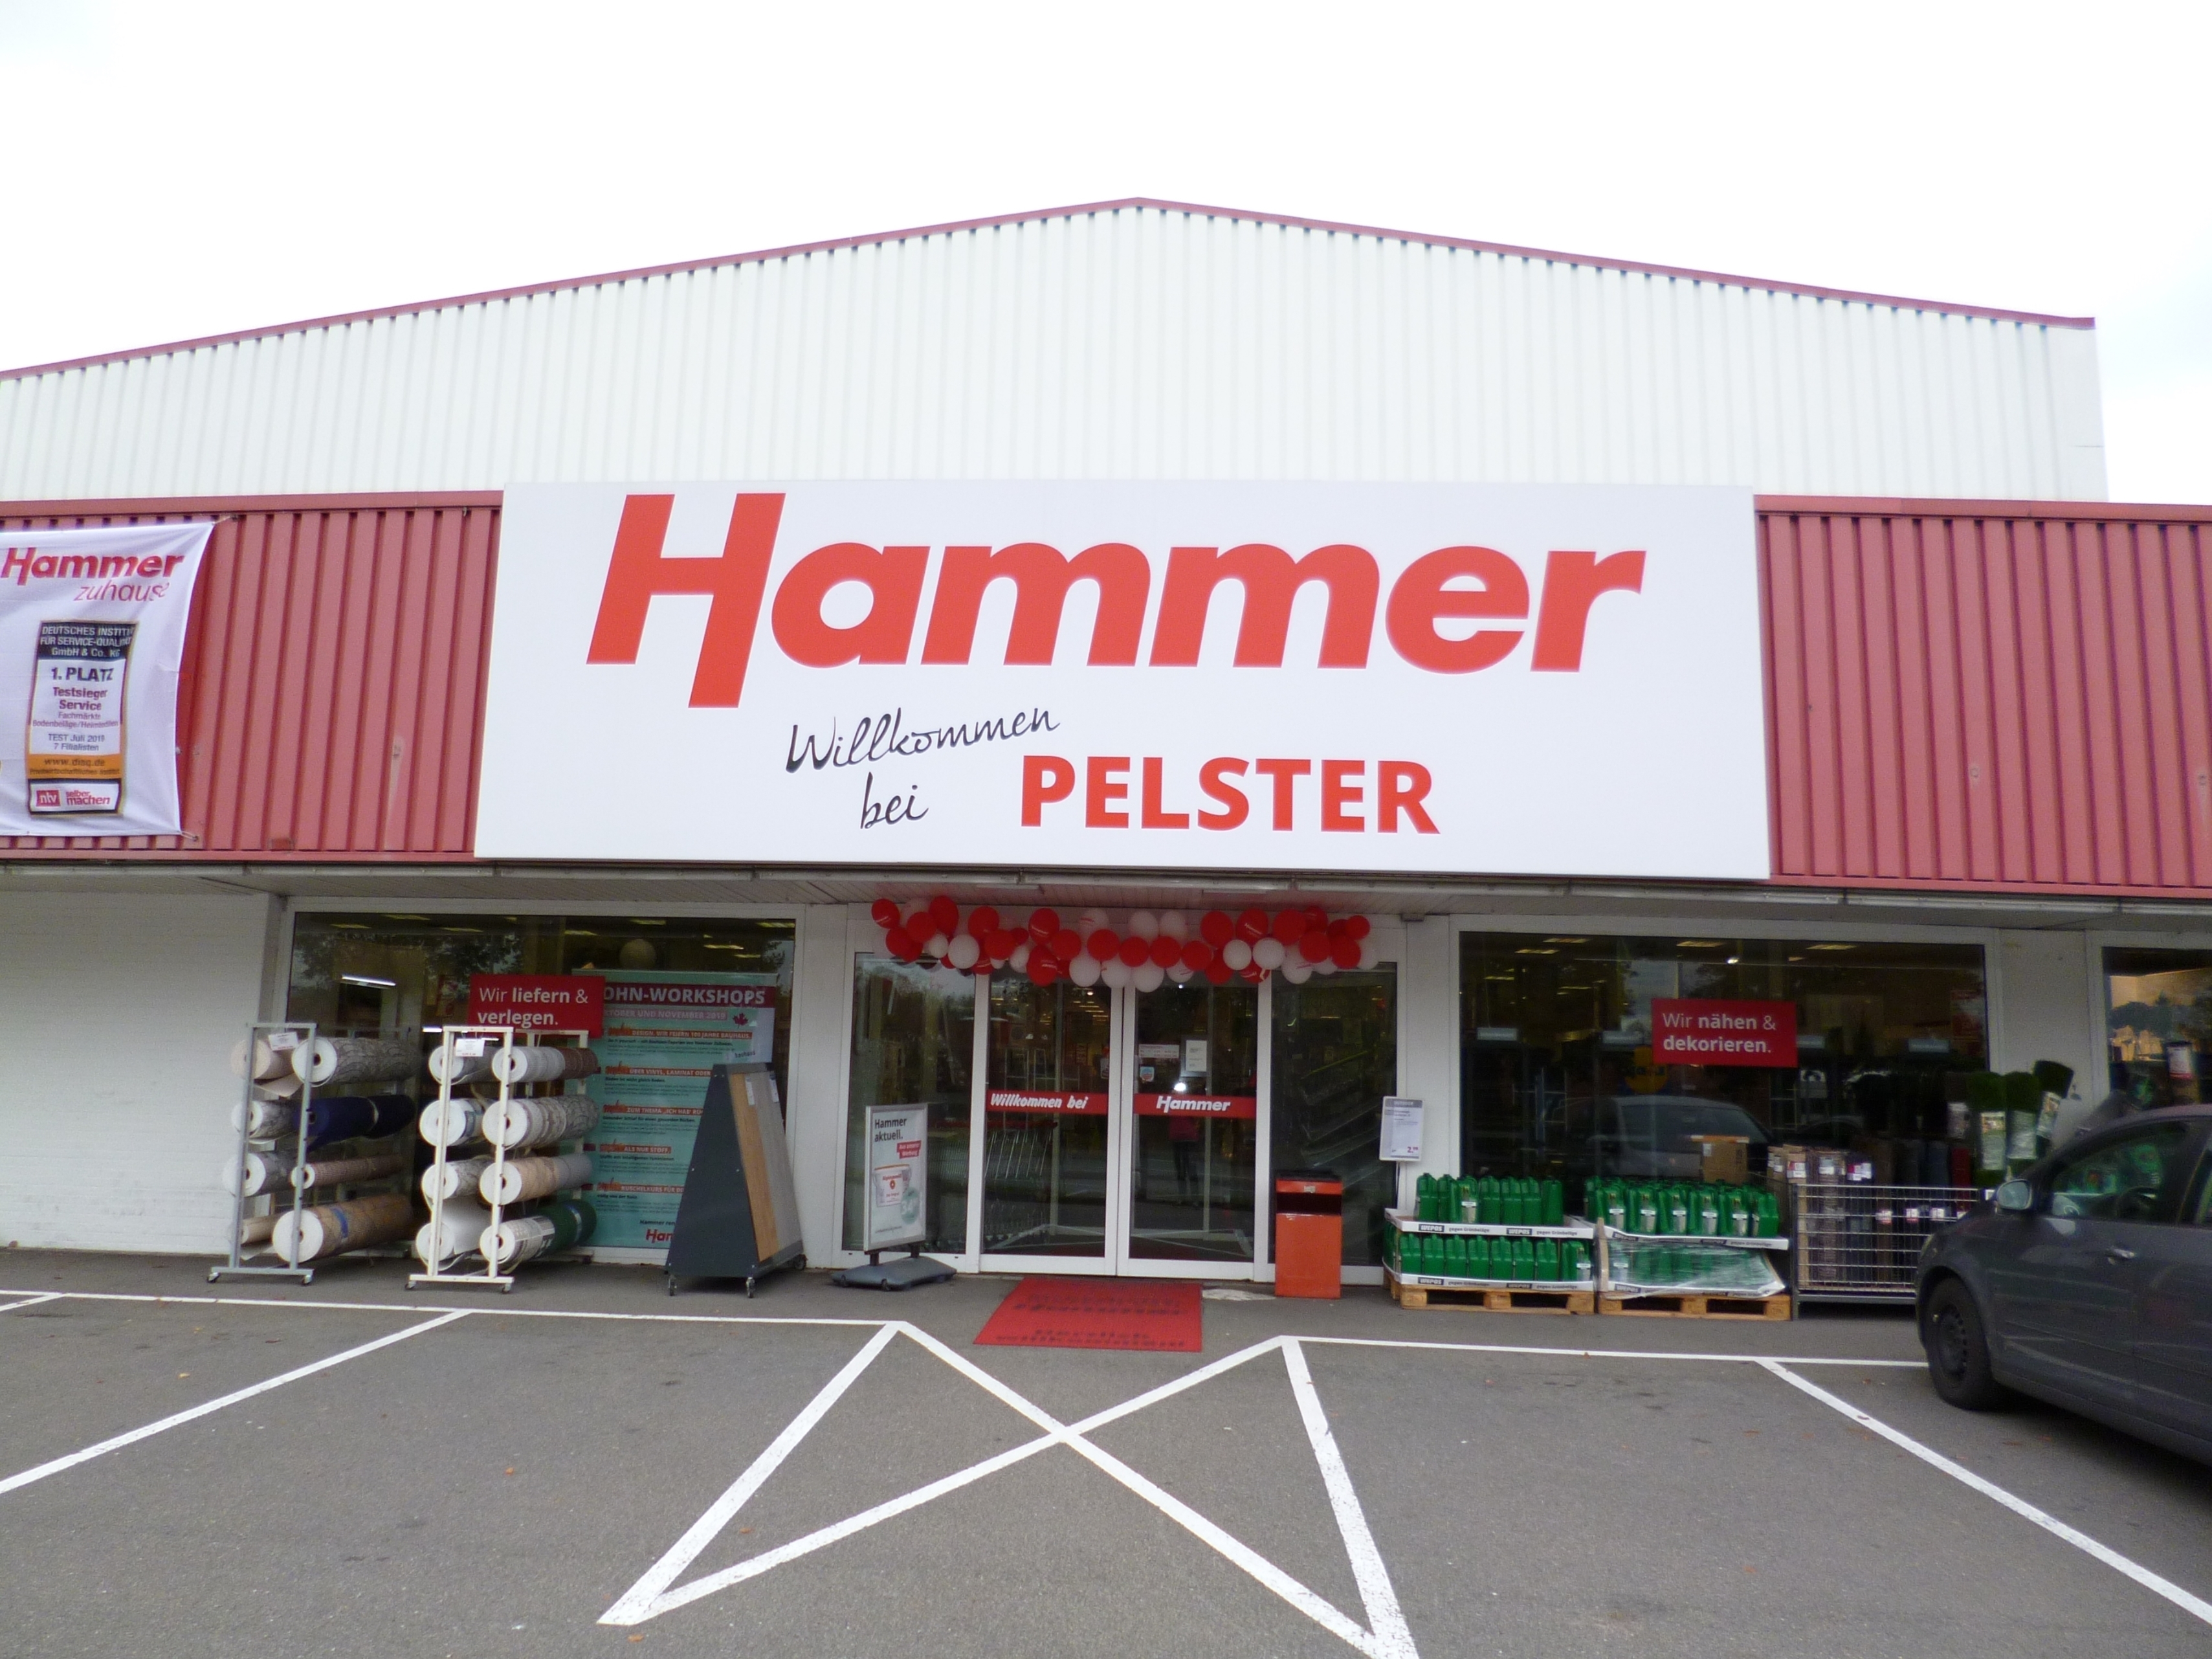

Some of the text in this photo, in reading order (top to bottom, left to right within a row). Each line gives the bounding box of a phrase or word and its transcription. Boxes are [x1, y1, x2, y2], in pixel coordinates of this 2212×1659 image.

[1, 547, 185, 586] Hammer
[587, 493, 1646, 707] Hammer
[42, 627, 134, 636] DEUTSCHES INSTIT
[52, 647, 79, 656] GmbH
[52, 667, 114, 682] 1. PLATZ
[53, 687, 107, 700] Testsieger
[59, 700, 102, 710] Service
[786, 707, 1060, 774] Willkommen
[67, 795, 111, 805] machen
[861, 772, 929, 829] bei
[1022, 755, 1439, 834] PELSTER
[480, 987, 588, 1003] Wir liefern &
[478, 1009, 559, 1029] verlegen.
[1663, 1013, 1776, 1030] Wir nähen &
[1663, 1035, 1772, 1053] dekorieren.
[990, 1093, 1089, 1109] Willkommen bei
[1156, 1096, 1231, 1113] Hammer
[874, 1118, 907, 1129] Hammer
[874, 1130, 903, 1142] aktuell.
